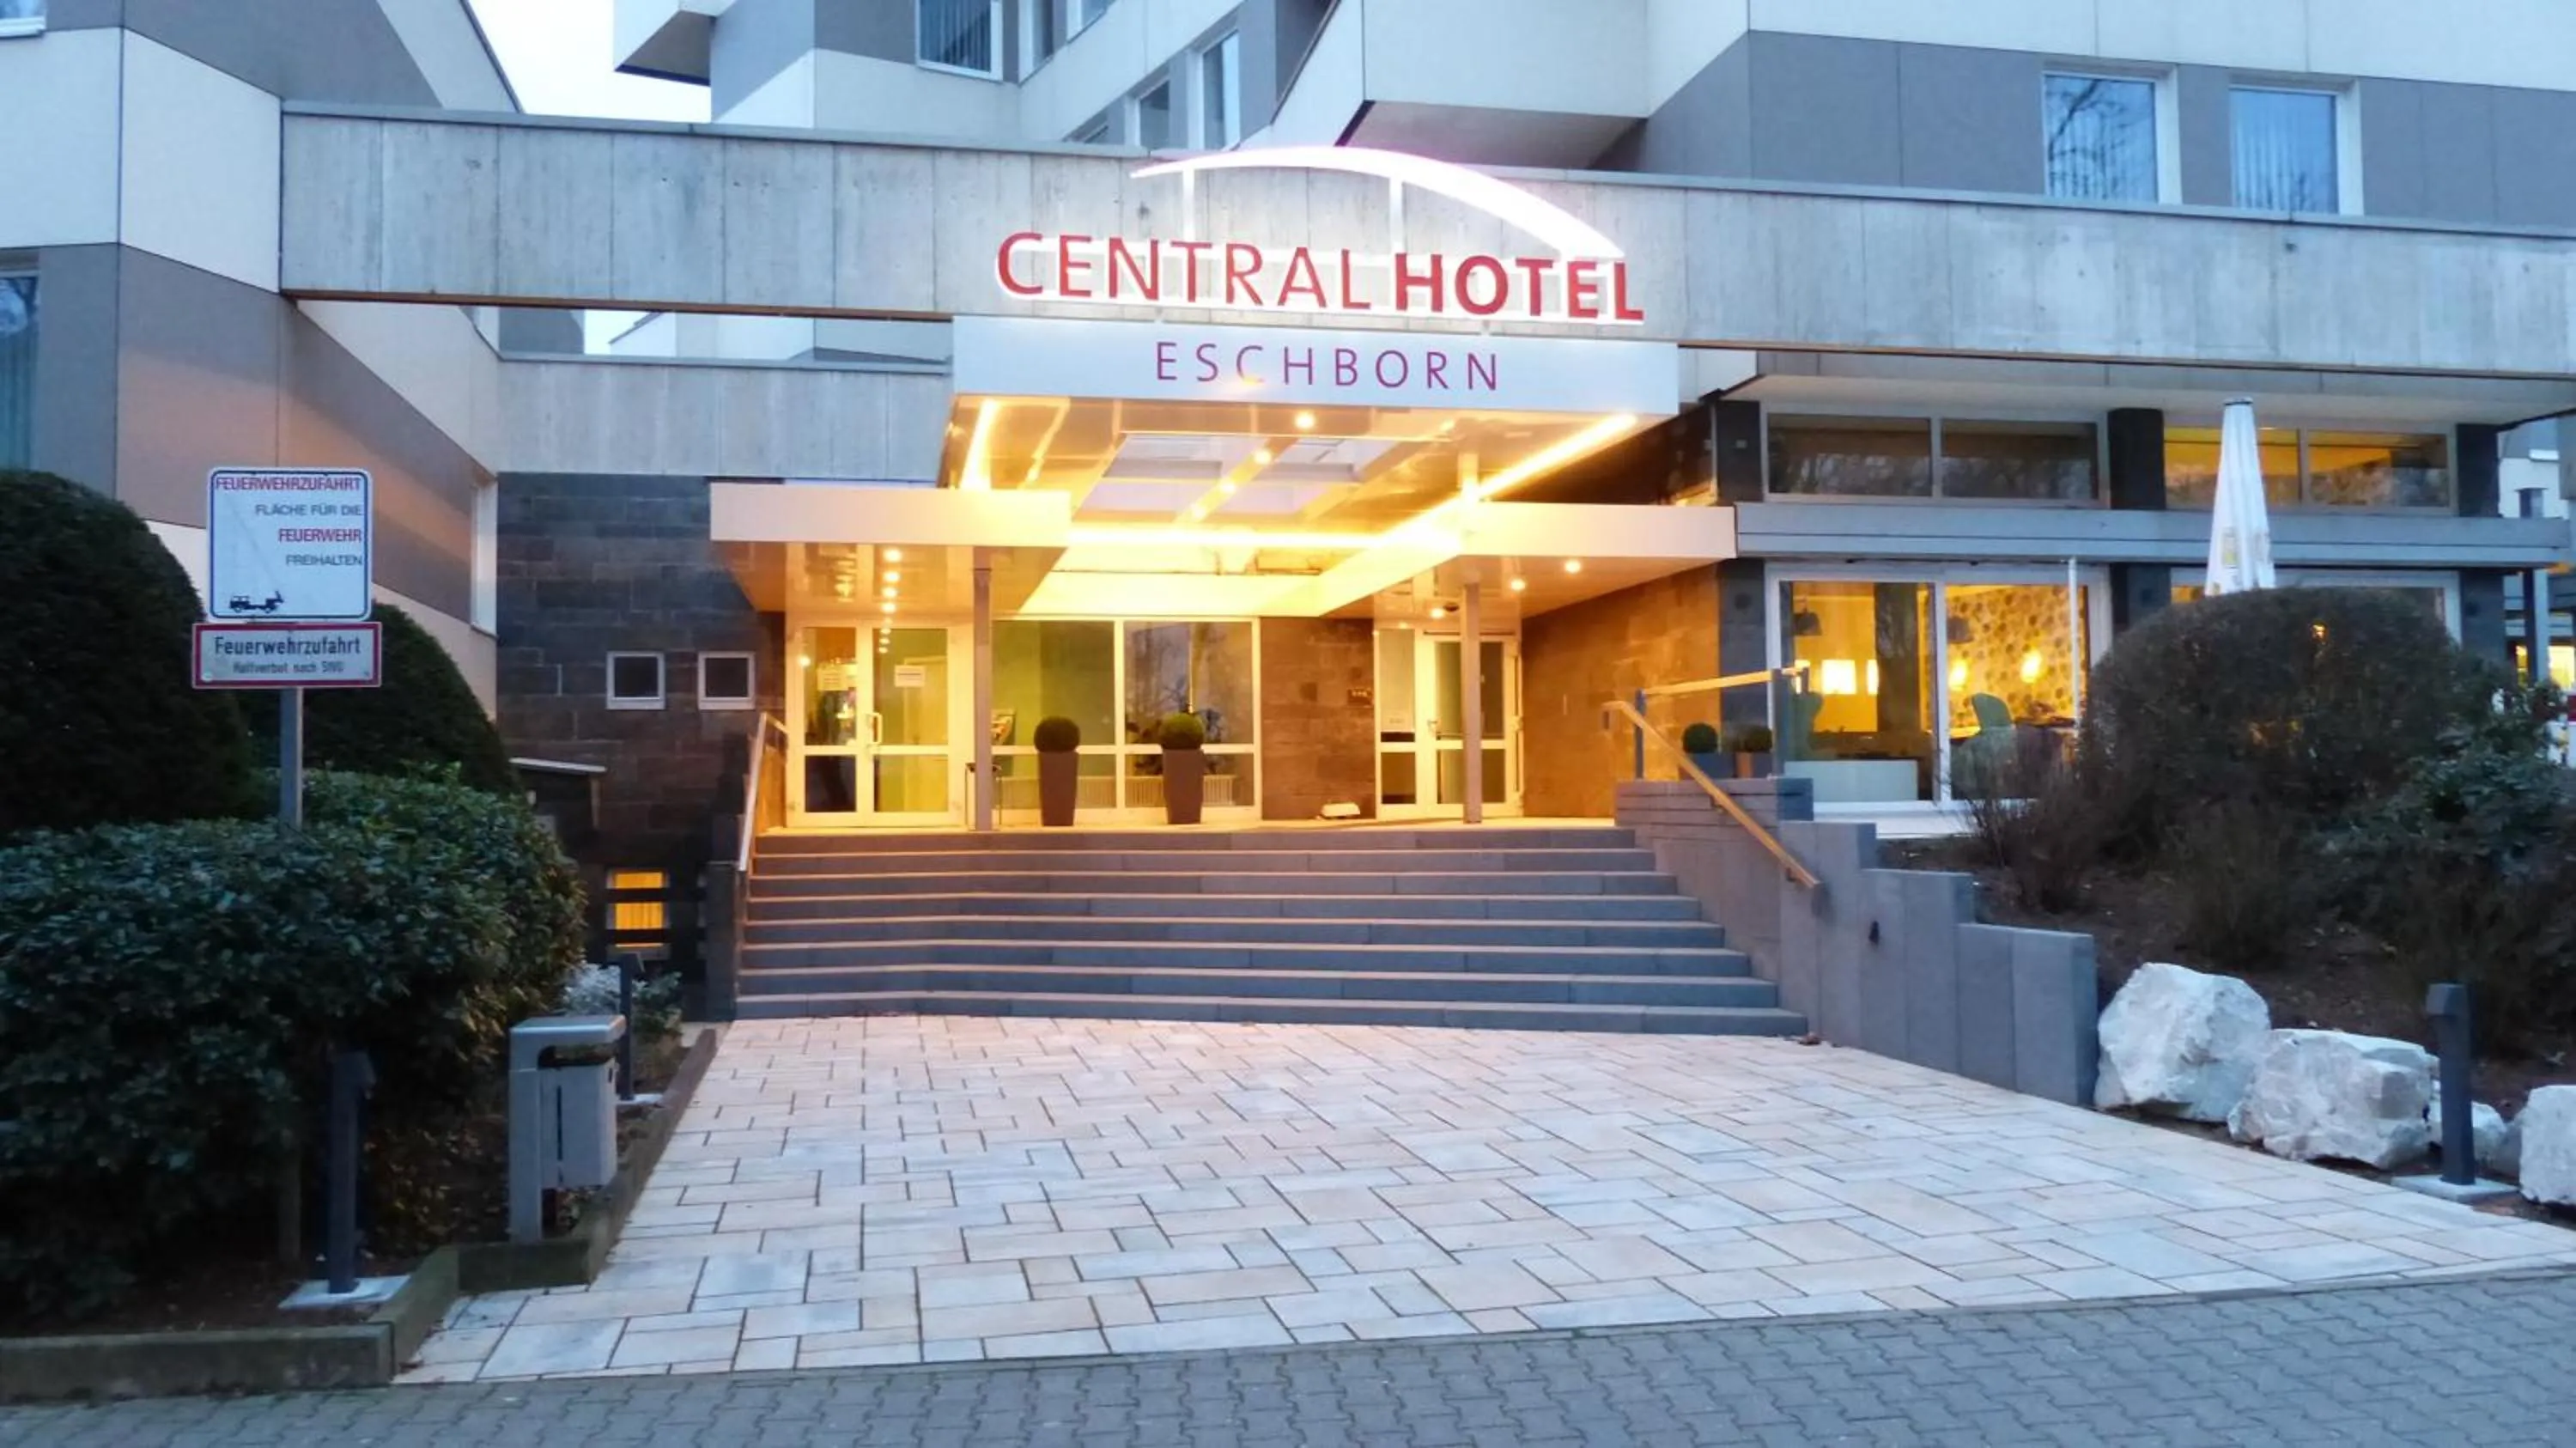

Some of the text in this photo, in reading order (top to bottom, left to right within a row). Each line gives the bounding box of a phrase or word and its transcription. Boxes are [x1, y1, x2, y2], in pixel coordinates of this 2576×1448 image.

[1156, 341, 1498, 391] ESCHBORN
[216, 478, 361, 490] FEUERWEHRZUFAHRT
[256, 502, 362, 516] FLÄCHE FÜR DIE
[278, 528, 362, 542] FEUERWEHR
[286, 555, 362, 566] FREIHALTEN
[215, 636, 361, 654] Feuerwehrzufahrt
